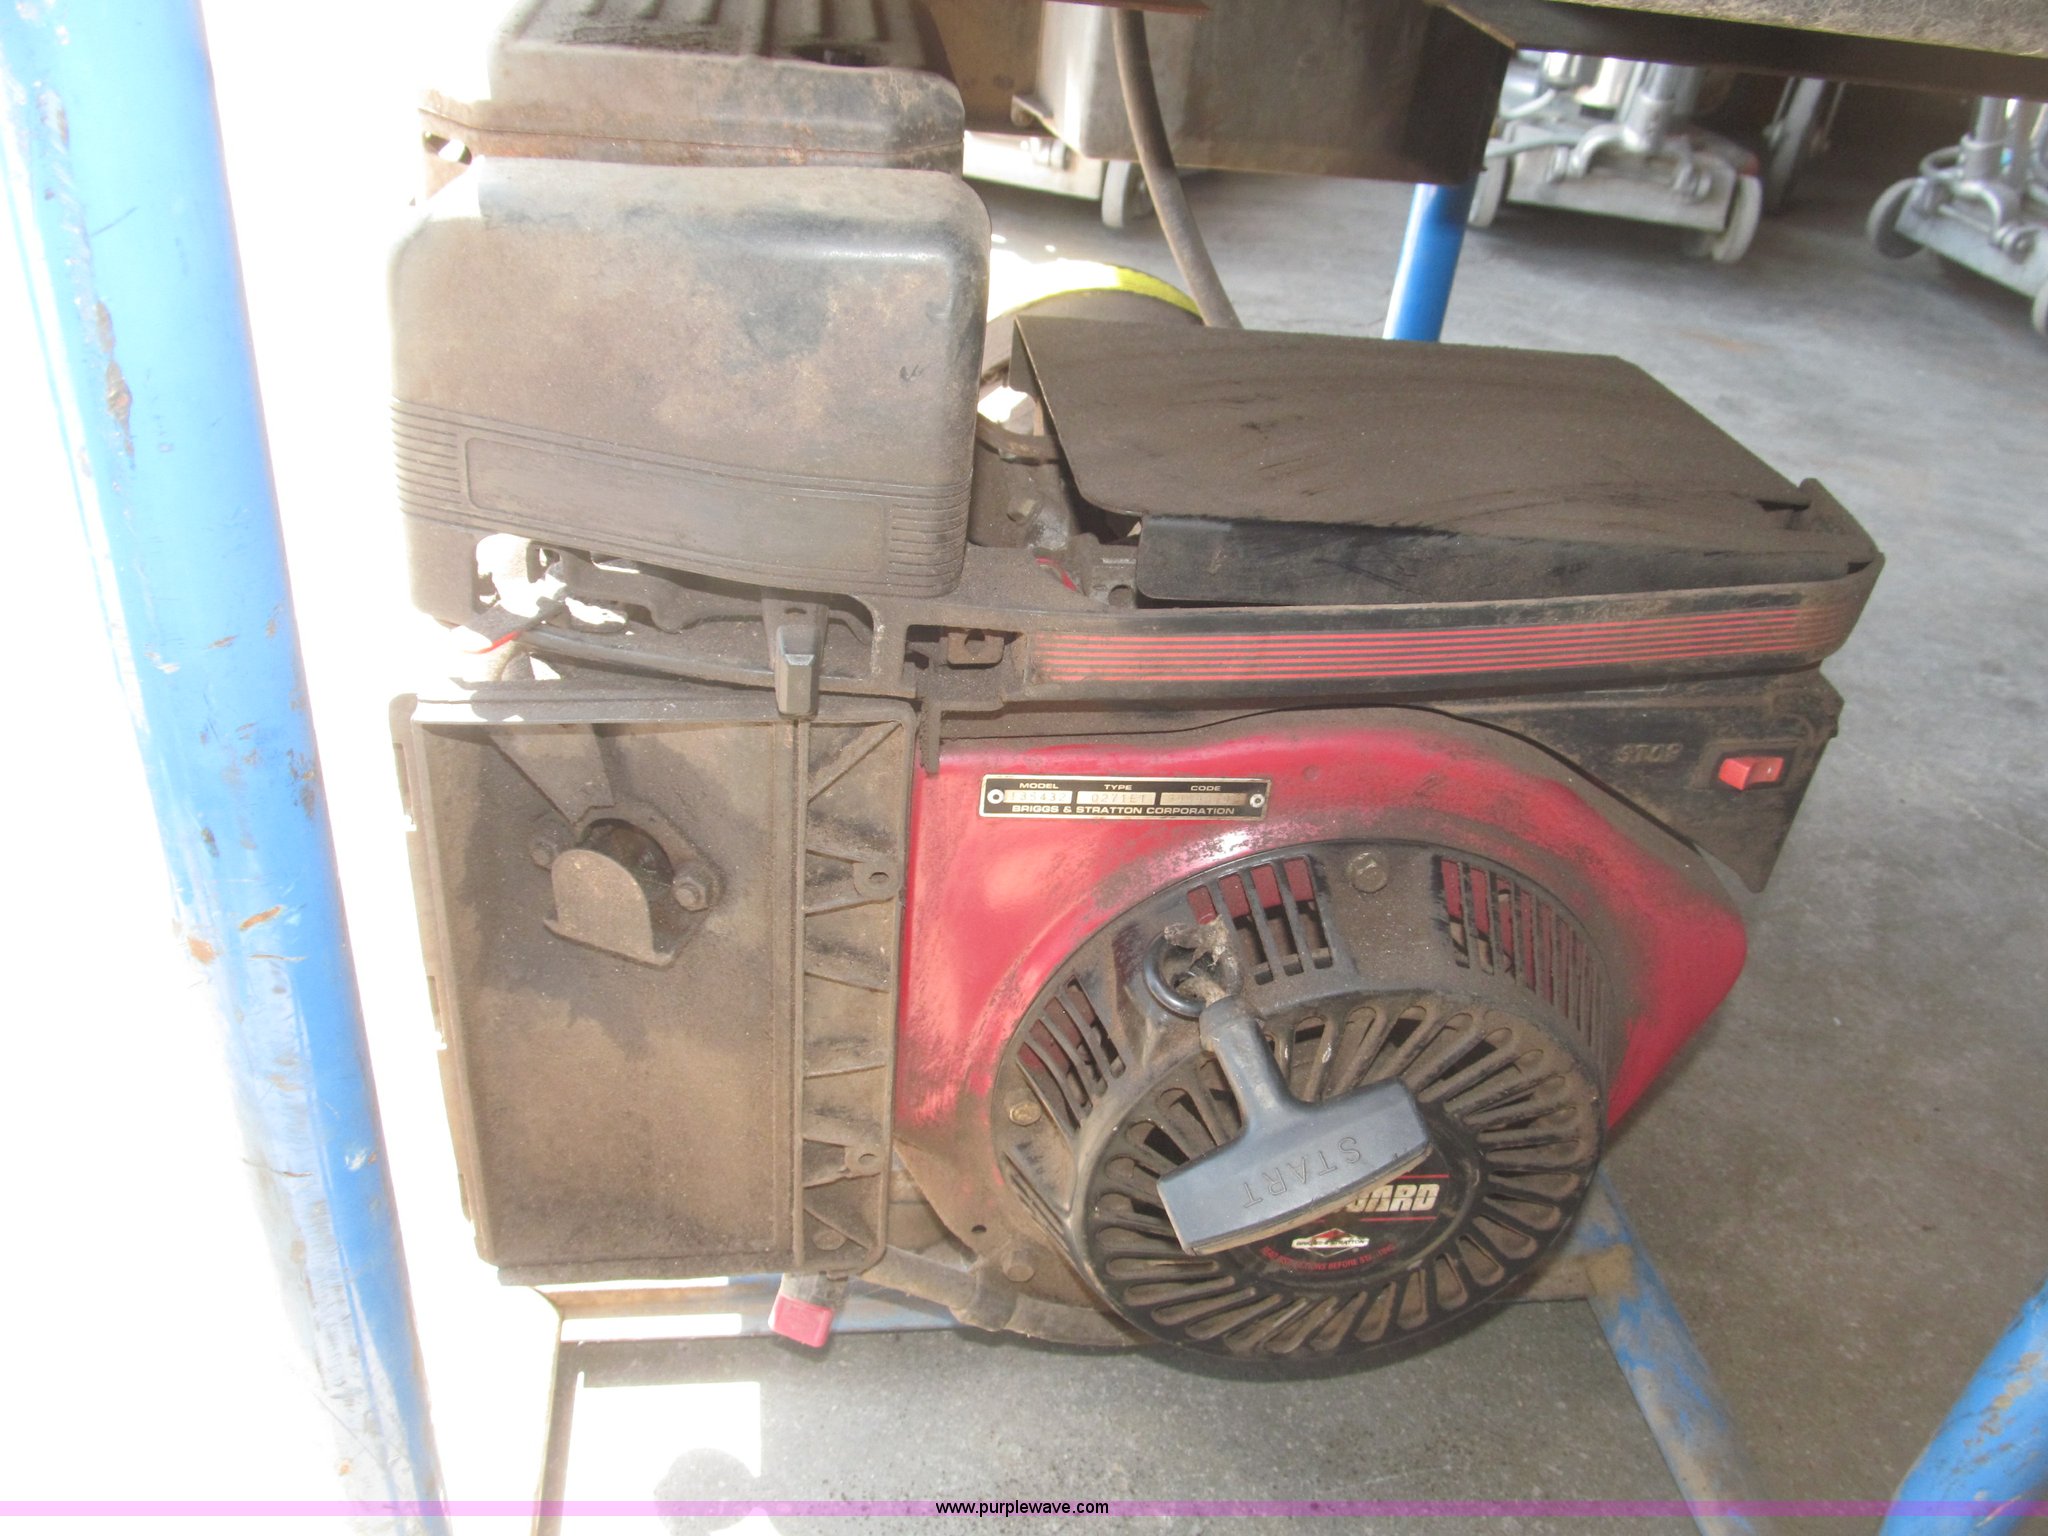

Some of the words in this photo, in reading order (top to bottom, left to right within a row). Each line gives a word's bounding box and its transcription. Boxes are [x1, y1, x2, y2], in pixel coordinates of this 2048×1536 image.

[1615, 742, 1683, 763] STOP
[1011, 804, 1059, 813] BRIGGS
[1062, 805, 1073, 813] &
[1075, 805, 1143, 815] STRATTON
[1145, 806, 1236, 815] CORPORATION
[1242, 1136, 1362, 1209] START
